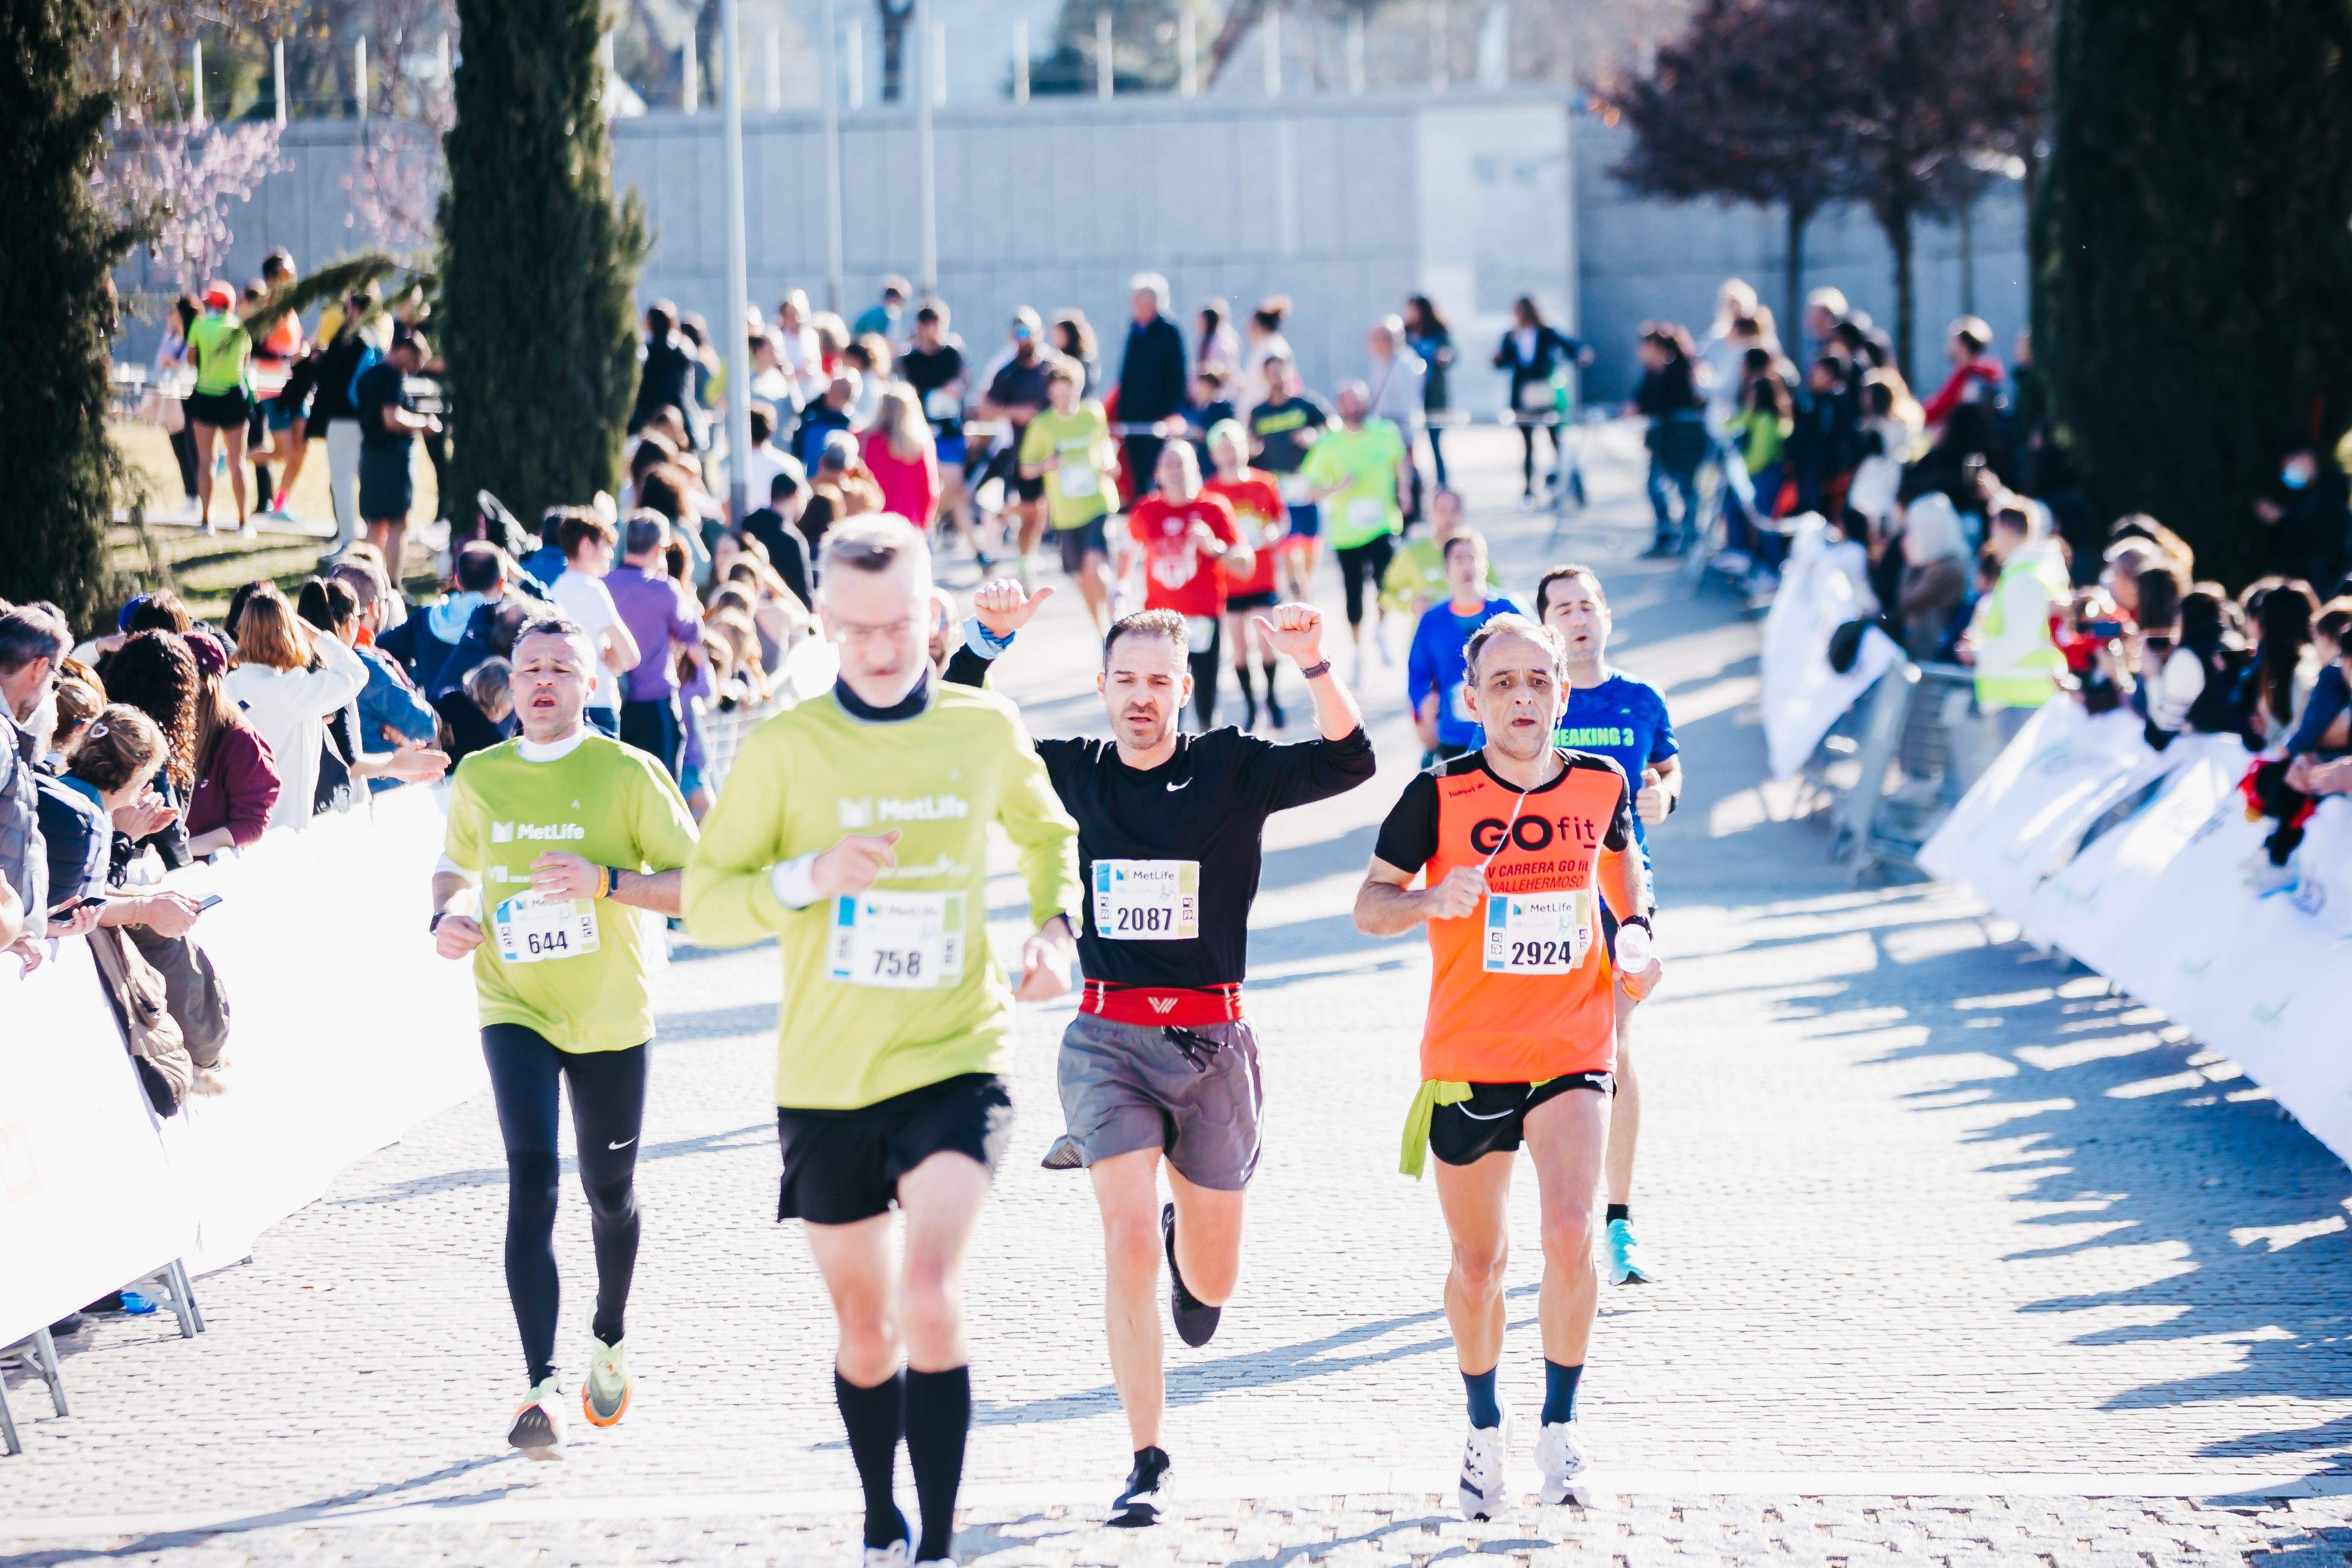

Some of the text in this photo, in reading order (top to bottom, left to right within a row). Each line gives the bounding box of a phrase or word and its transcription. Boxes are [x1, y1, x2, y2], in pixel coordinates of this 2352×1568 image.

[1552, 727, 1634, 747] REAKING 3
[878, 793, 968, 823] MetLife
[517, 823, 585, 841] MetLife
[1134, 871, 1174, 880] MetLife
[1499, 861, 1554, 877] CARRERA
[1559, 860, 1575, 872] GO
[1491, 876, 1584, 893] VALLEHERMOSO
[1530, 903, 1572, 912] MetLife
[1118, 908, 1172, 931] 2087
[528, 931, 568, 954] 644
[875, 949, 921, 977] 758
[1512, 941, 1571, 965] 2924
